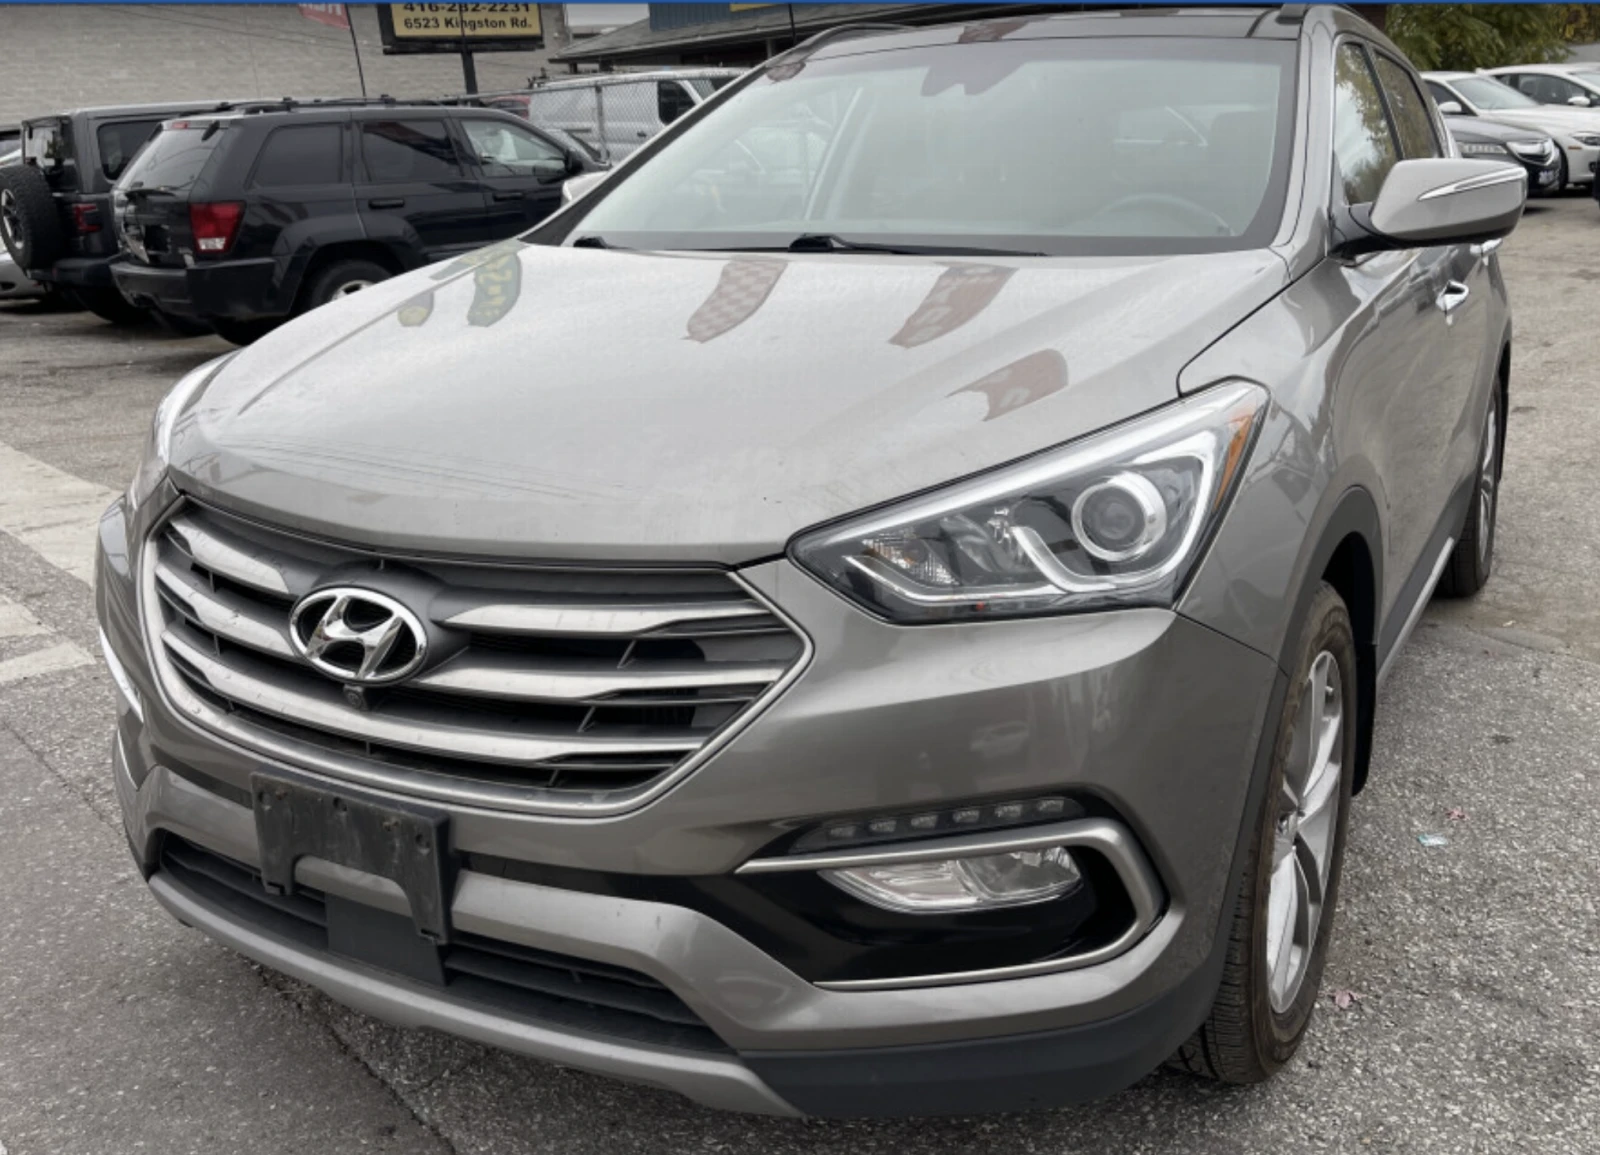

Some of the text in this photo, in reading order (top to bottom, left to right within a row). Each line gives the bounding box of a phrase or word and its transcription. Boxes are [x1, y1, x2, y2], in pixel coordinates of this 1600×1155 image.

[403, 16, 532, 31] 6523 Kingston Rd.
